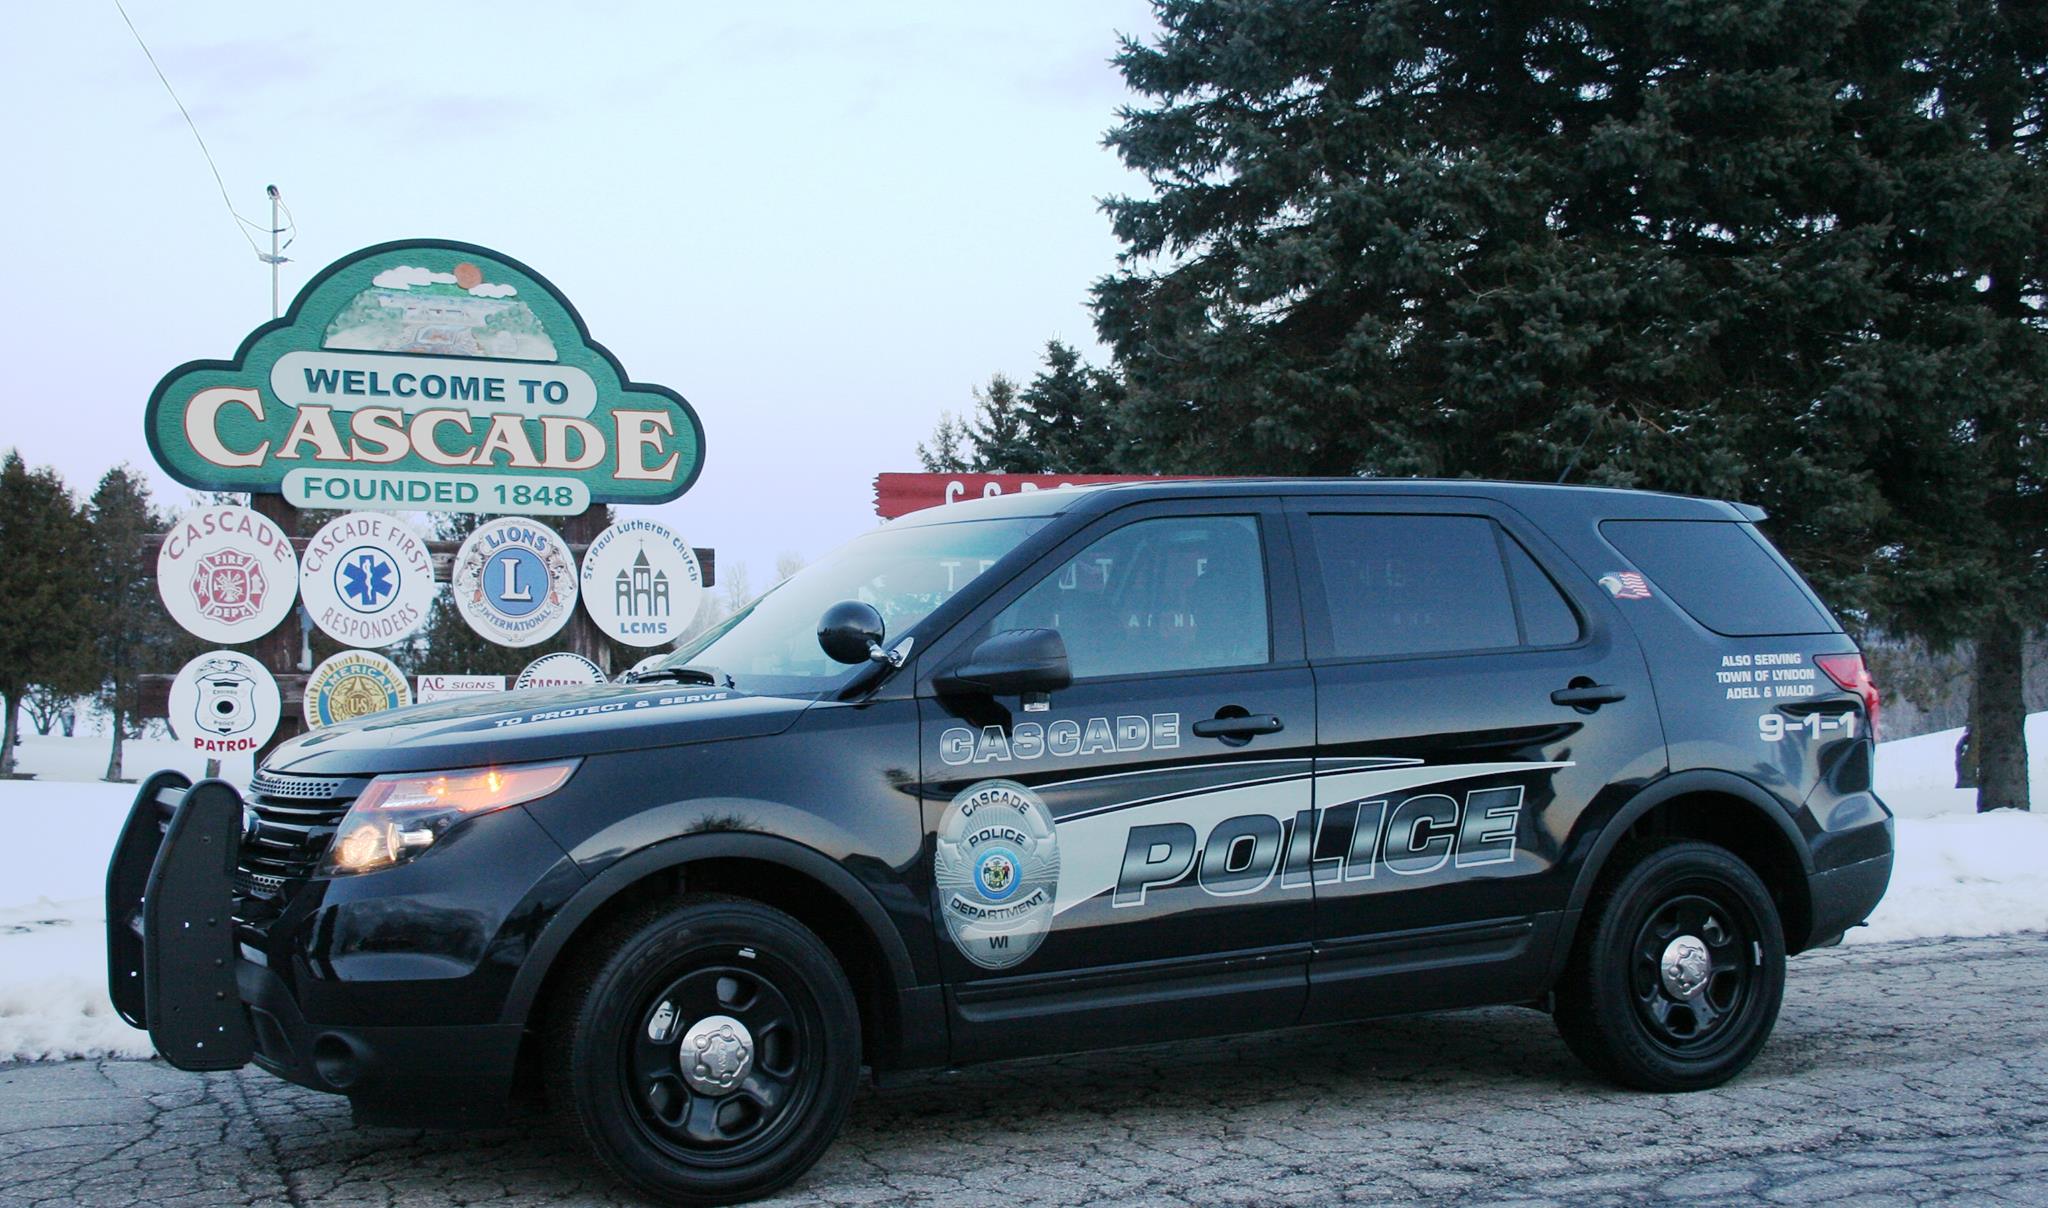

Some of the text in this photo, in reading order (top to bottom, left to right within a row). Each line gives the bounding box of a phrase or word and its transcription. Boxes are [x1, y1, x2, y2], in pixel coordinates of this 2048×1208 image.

[304, 368, 569, 404] WELCOME TO
[184, 387, 680, 481] CASCADE
[303, 477, 573, 507] FOUNDED 1848
[168, 511, 289, 562] CASCADE
[306, 519, 429, 573] CASCADE FIRST
[485, 527, 547, 551] LIONS
[591, 530, 615, 557] Paul
[617, 520, 670, 539] Lutheran
[672, 537, 698, 581] Church
[215, 554, 245, 565] FIRE
[500, 558, 533, 601] L
[321, 602, 419, 640] RESPONDERS
[480, 606, 551, 631] INTERNATIONAL
[620, 622, 668, 634] LCMS
[1721, 653, 1801, 667] ALSO SERVING
[323, 665, 395, 695] AMERICAN
[421, 677, 496, 691] AC SIGNS
[1716, 668, 1815, 683] TOWN OF LYNDON
[1726, 687, 1760, 700] ADELL
[1776, 685, 1814, 697] WALDO
[495, 717, 522, 727] TO
[531, 702, 628, 721] PROTECT
[659, 692, 728, 705] SERVE
[940, 713, 1181, 766] CASCADE
[1758, 711, 1855, 742] 9-1-1
[194, 737, 257, 752] PATROL
[961, 791, 1030, 817] CASCADE
[969, 828, 1026, 847] POLICE
[1111, 784, 1525, 908] POLICE
[951, 891, 1044, 920] DEPARTMENT
[989, 935, 1008, 949] WI
